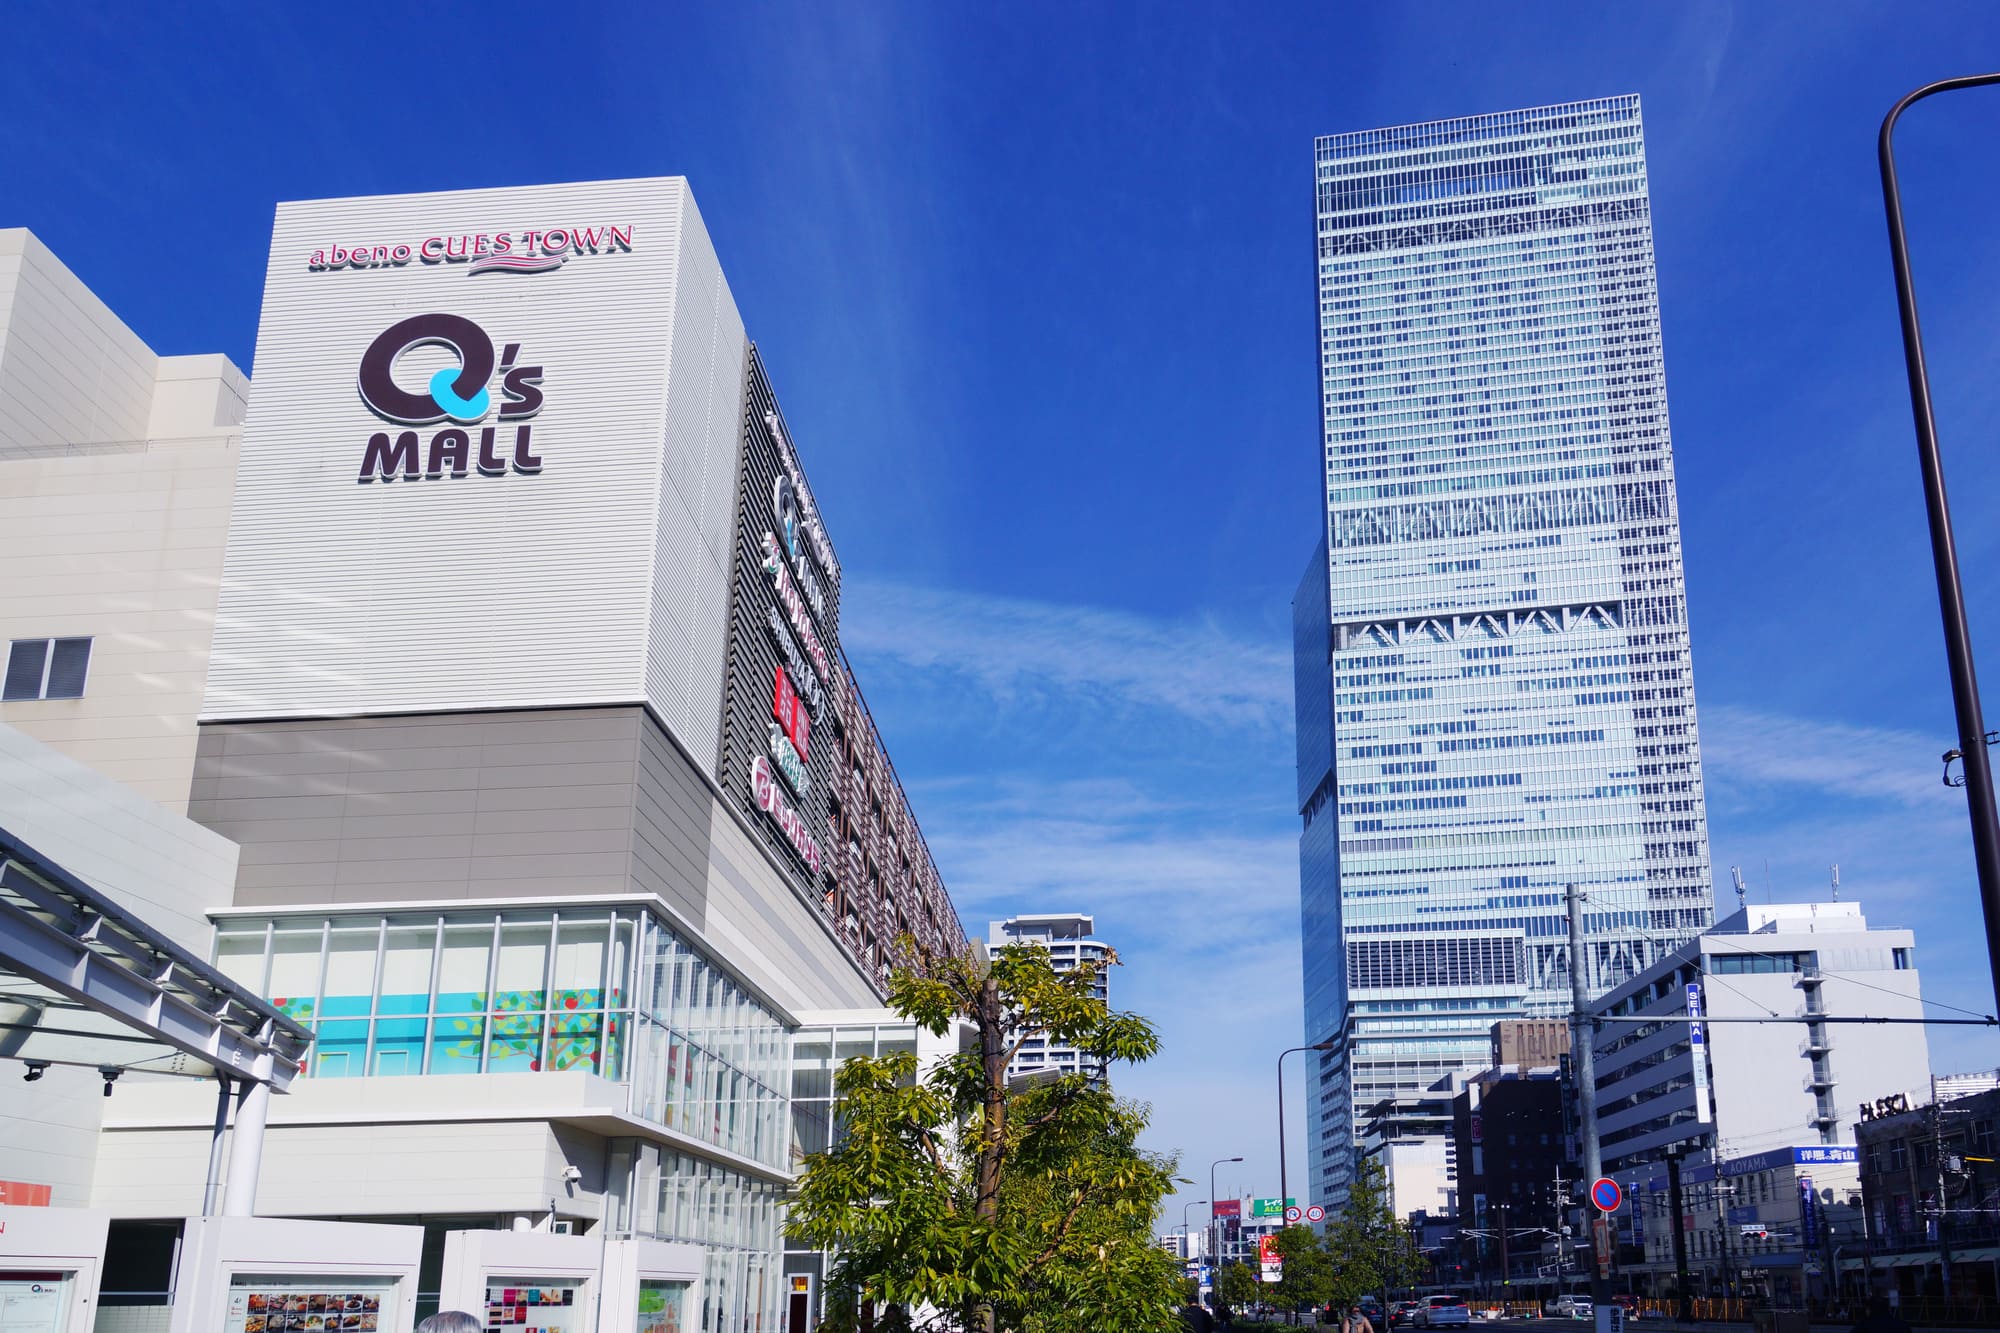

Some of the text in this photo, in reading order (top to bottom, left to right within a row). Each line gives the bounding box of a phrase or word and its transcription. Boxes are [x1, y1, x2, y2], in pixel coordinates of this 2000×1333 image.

[308, 225, 634, 268] abeno CUES TOWN
[357, 313, 545, 424] Q's
[358, 425, 544, 482] MALL
[1730, 1156, 1768, 1175] AOYAMA
[1310, 1209, 1321, 1218] 40
